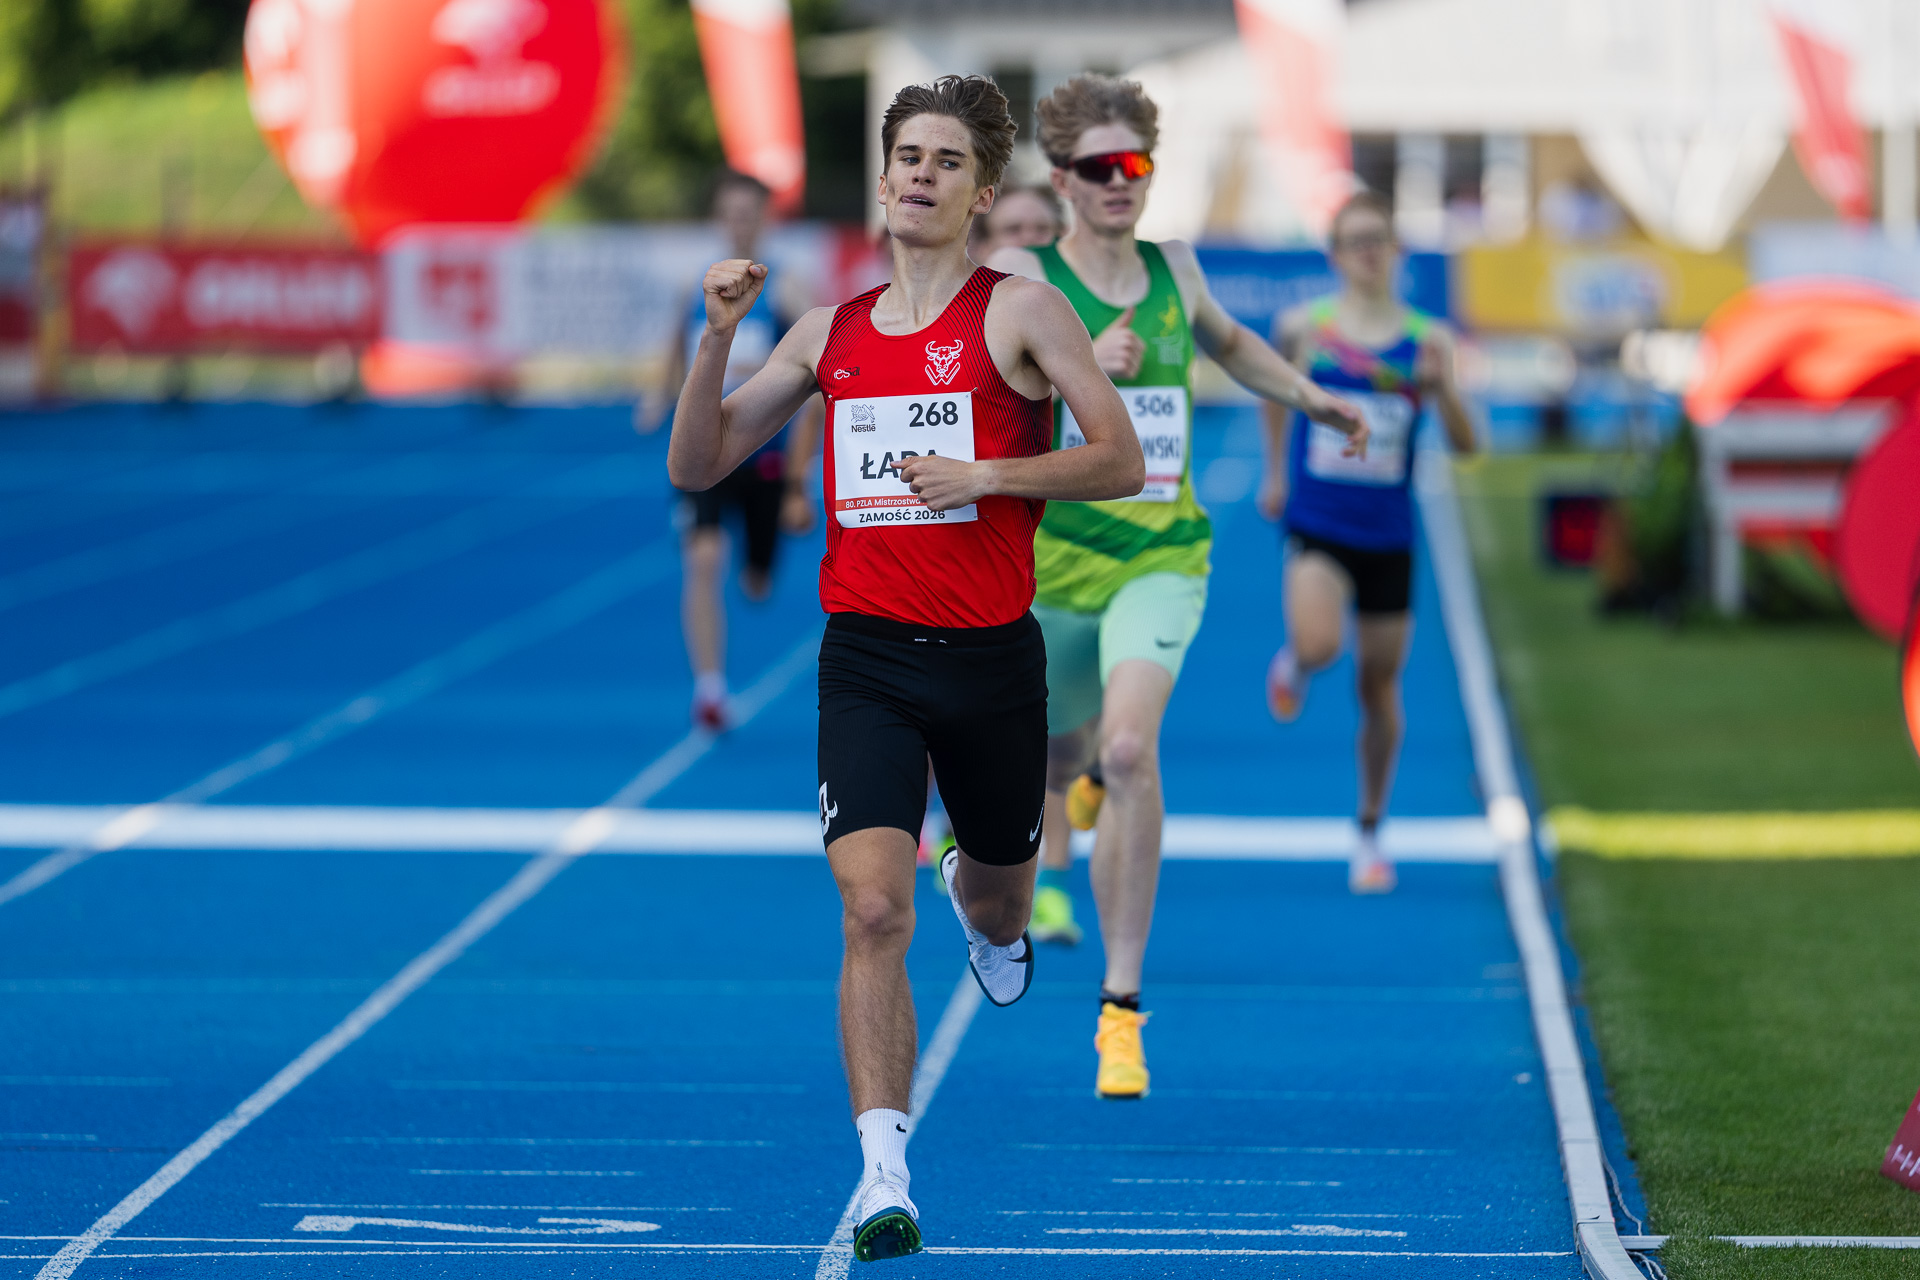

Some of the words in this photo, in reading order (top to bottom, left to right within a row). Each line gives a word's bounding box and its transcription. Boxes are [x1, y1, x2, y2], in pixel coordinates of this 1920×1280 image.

[908, 401, 958, 427] 268
[1134, 394, 1175, 417] 506
[851, 424, 876, 432] Nestlé
[860, 449, 937, 479] ŁA
[845, 501, 856, 509] 80.
[874, 497, 920, 506] Mistrzostwa
[859, 508, 911, 523] ZAMOŚĆ
[914, 510, 946, 520] 2026
